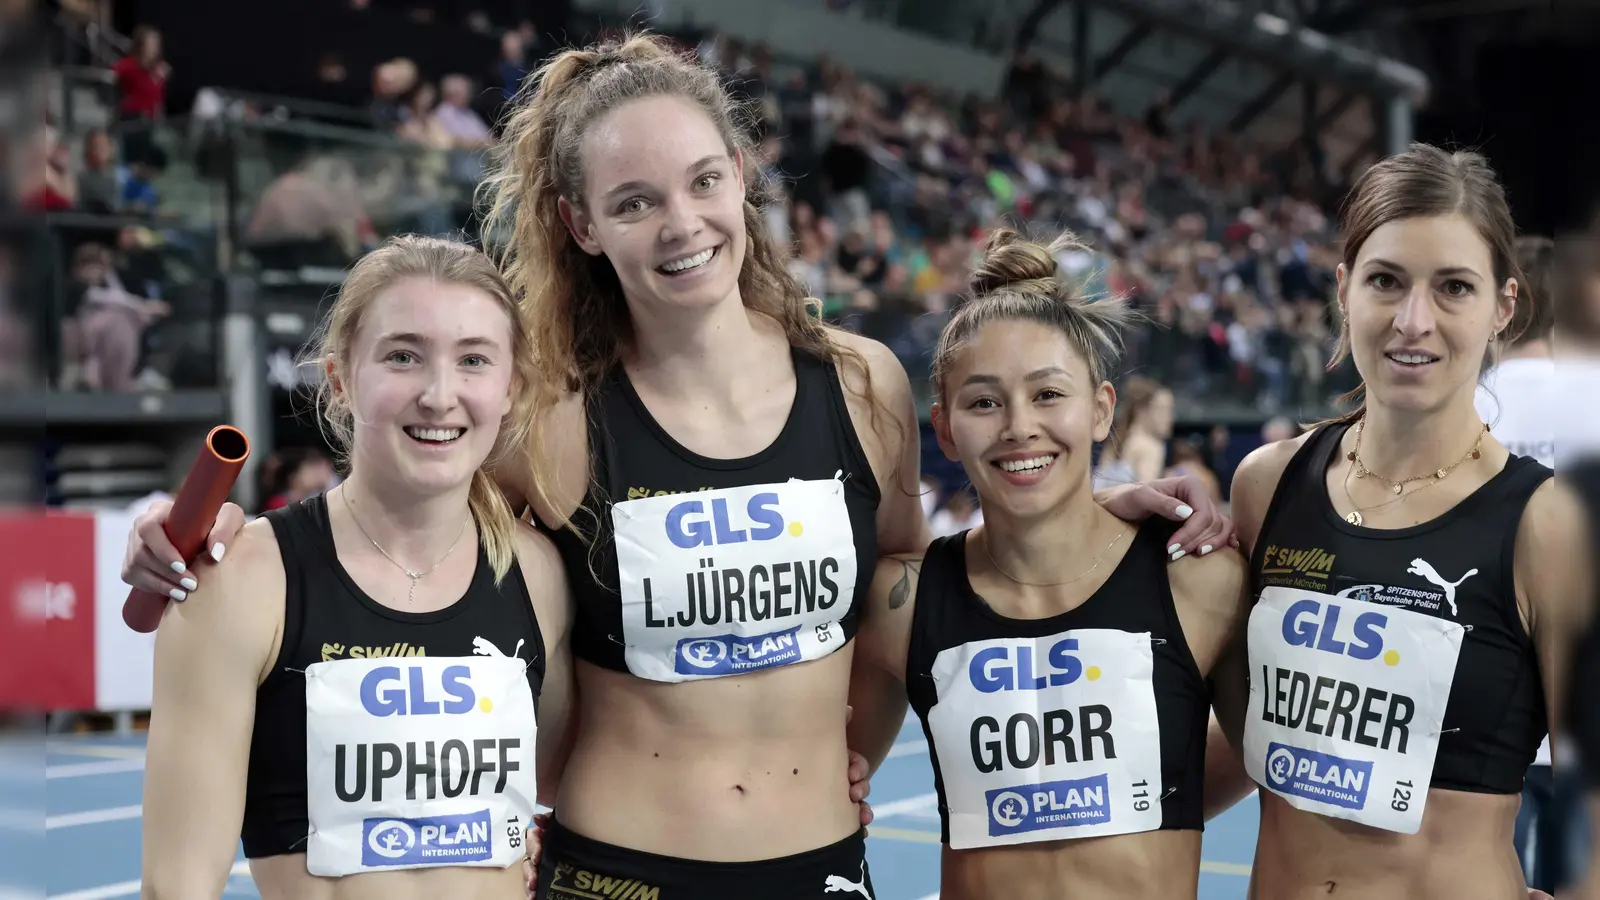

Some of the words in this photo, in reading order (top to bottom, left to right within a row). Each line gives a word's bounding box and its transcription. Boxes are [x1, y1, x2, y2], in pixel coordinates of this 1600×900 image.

[643, 557, 839, 628] L.JÜRGENS
[1374, 593, 1413, 606] Bayerische
[1414, 600, 1441, 611] Polizei
[1386, 586, 1443, 602] SPITZENSPORT
[814, 620, 833, 643] 25
[731, 633, 793, 659] PLAN
[731, 650, 797, 669] INTERNATIONAL
[1262, 664, 1415, 755] LEDERER
[969, 704, 1117, 773] GORR
[335, 738, 520, 803] UPHOFF
[1295, 758, 1364, 792] PLAN
[1032, 785, 1104, 812] PLAN
[1131, 779, 1150, 812] 119
[1293, 781, 1359, 804] INTERNATIONAL
[1391, 779, 1413, 812] 129
[1036, 810, 1105, 824] INTERNATIONAL
[421, 821, 488, 845] PLAN
[506, 815, 521, 848] 138
[422, 846, 488, 857] INTERNATIONAL
